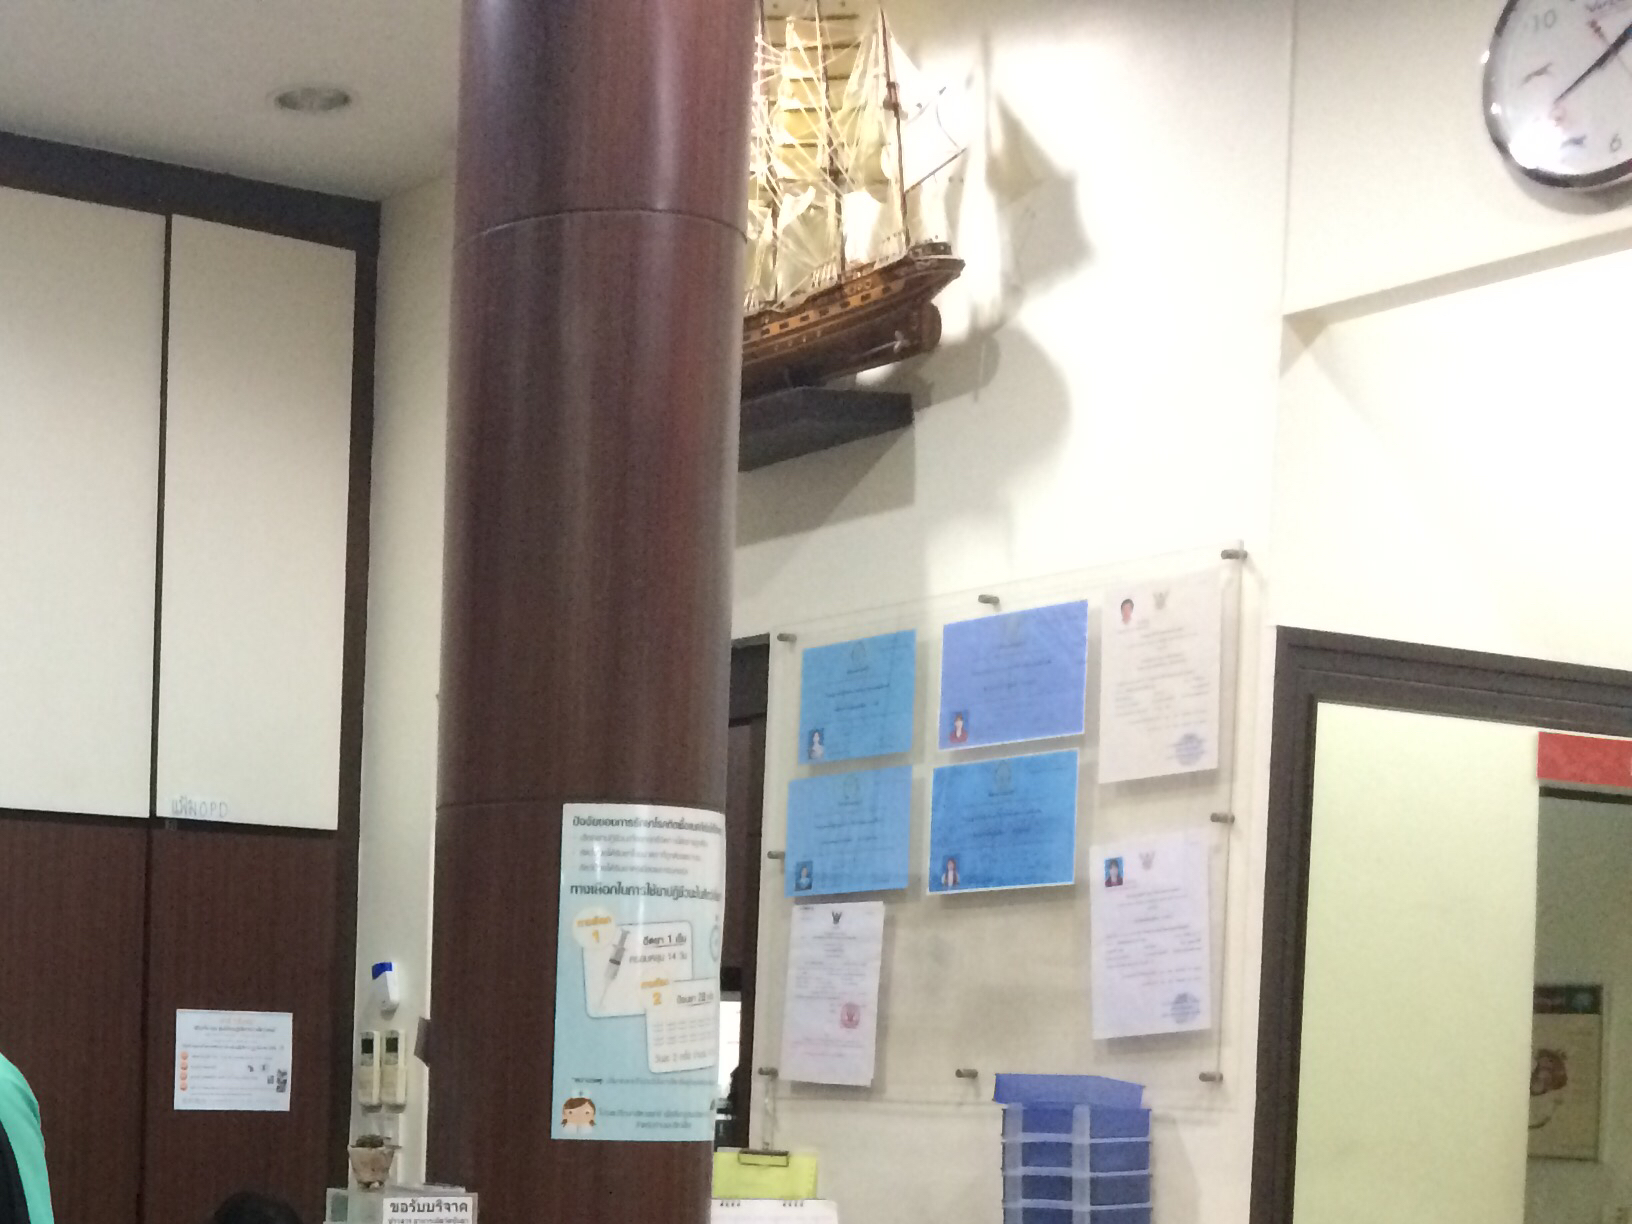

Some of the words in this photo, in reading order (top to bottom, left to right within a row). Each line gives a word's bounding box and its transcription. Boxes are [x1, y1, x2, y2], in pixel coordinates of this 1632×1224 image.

[667, 934, 672, 943] 1
[389, 1198, 468, 1213] ขอรับบริจาค
